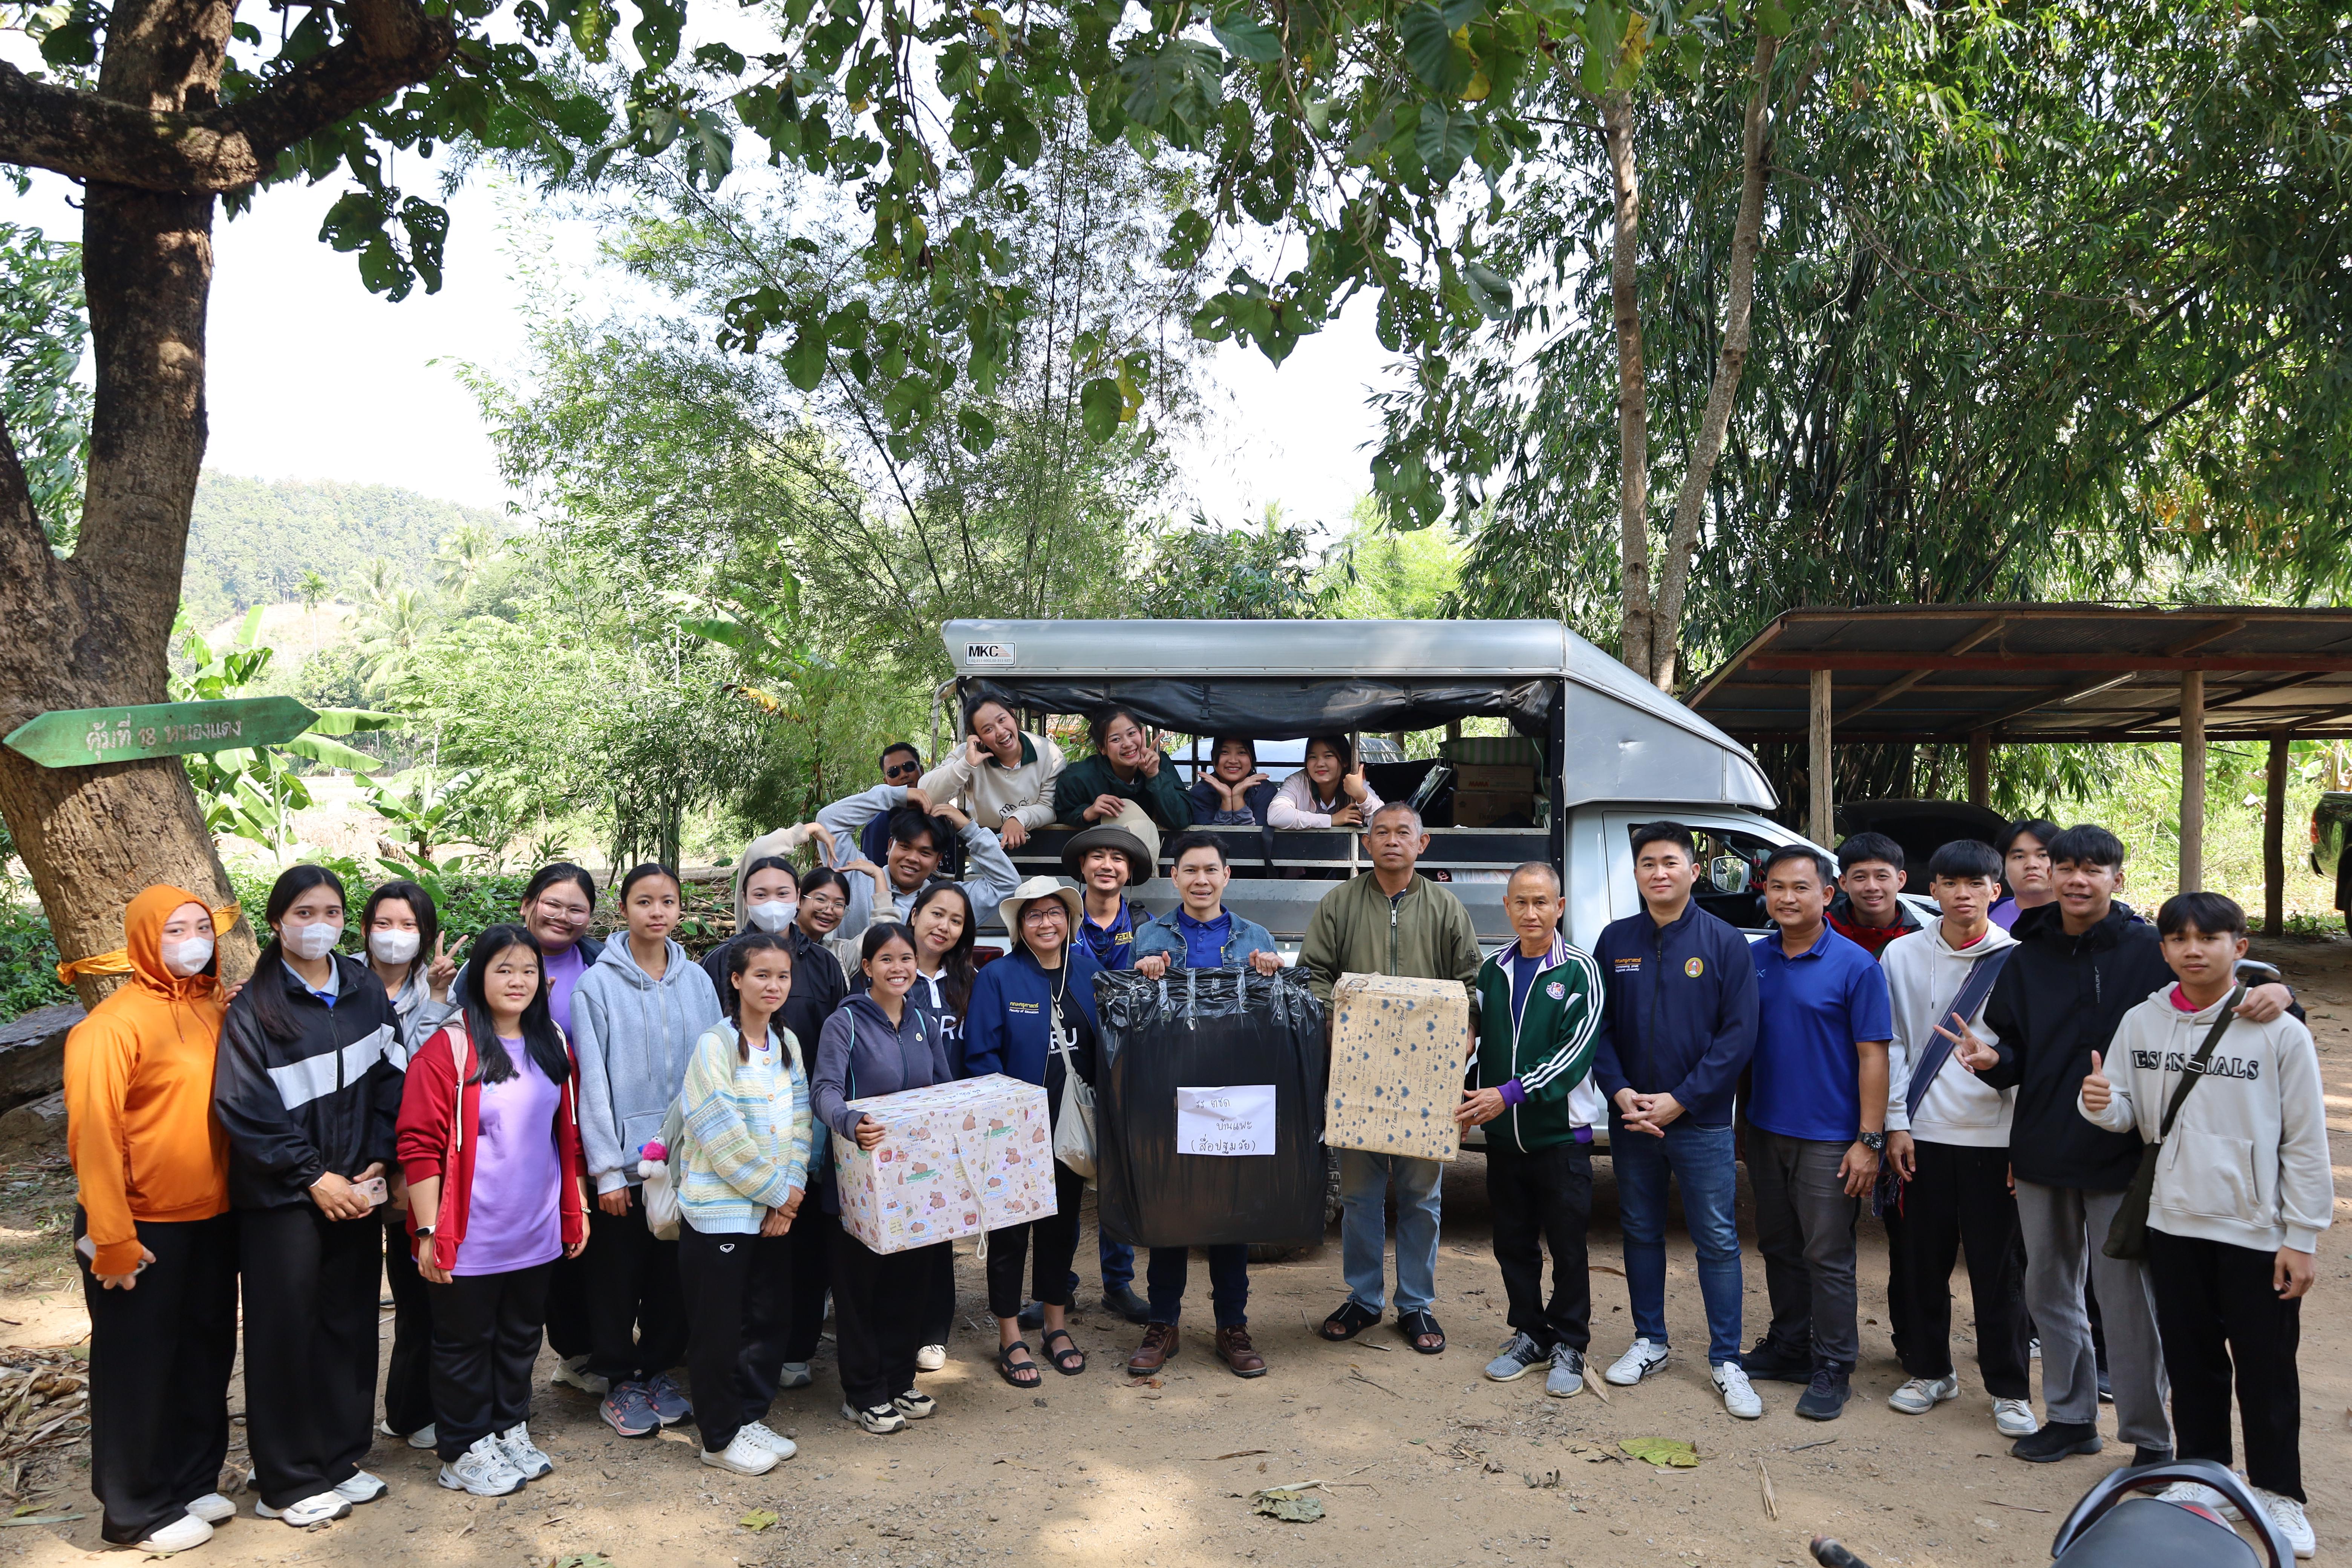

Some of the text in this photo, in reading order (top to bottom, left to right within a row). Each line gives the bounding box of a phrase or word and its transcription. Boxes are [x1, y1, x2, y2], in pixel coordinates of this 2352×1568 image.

[969, 646, 998, 657] MKC
[86, 712, 242, 761] คุ้มที่ 18 หนองแดง
[1216, 1118, 1252, 1130] บ้านแพะ
